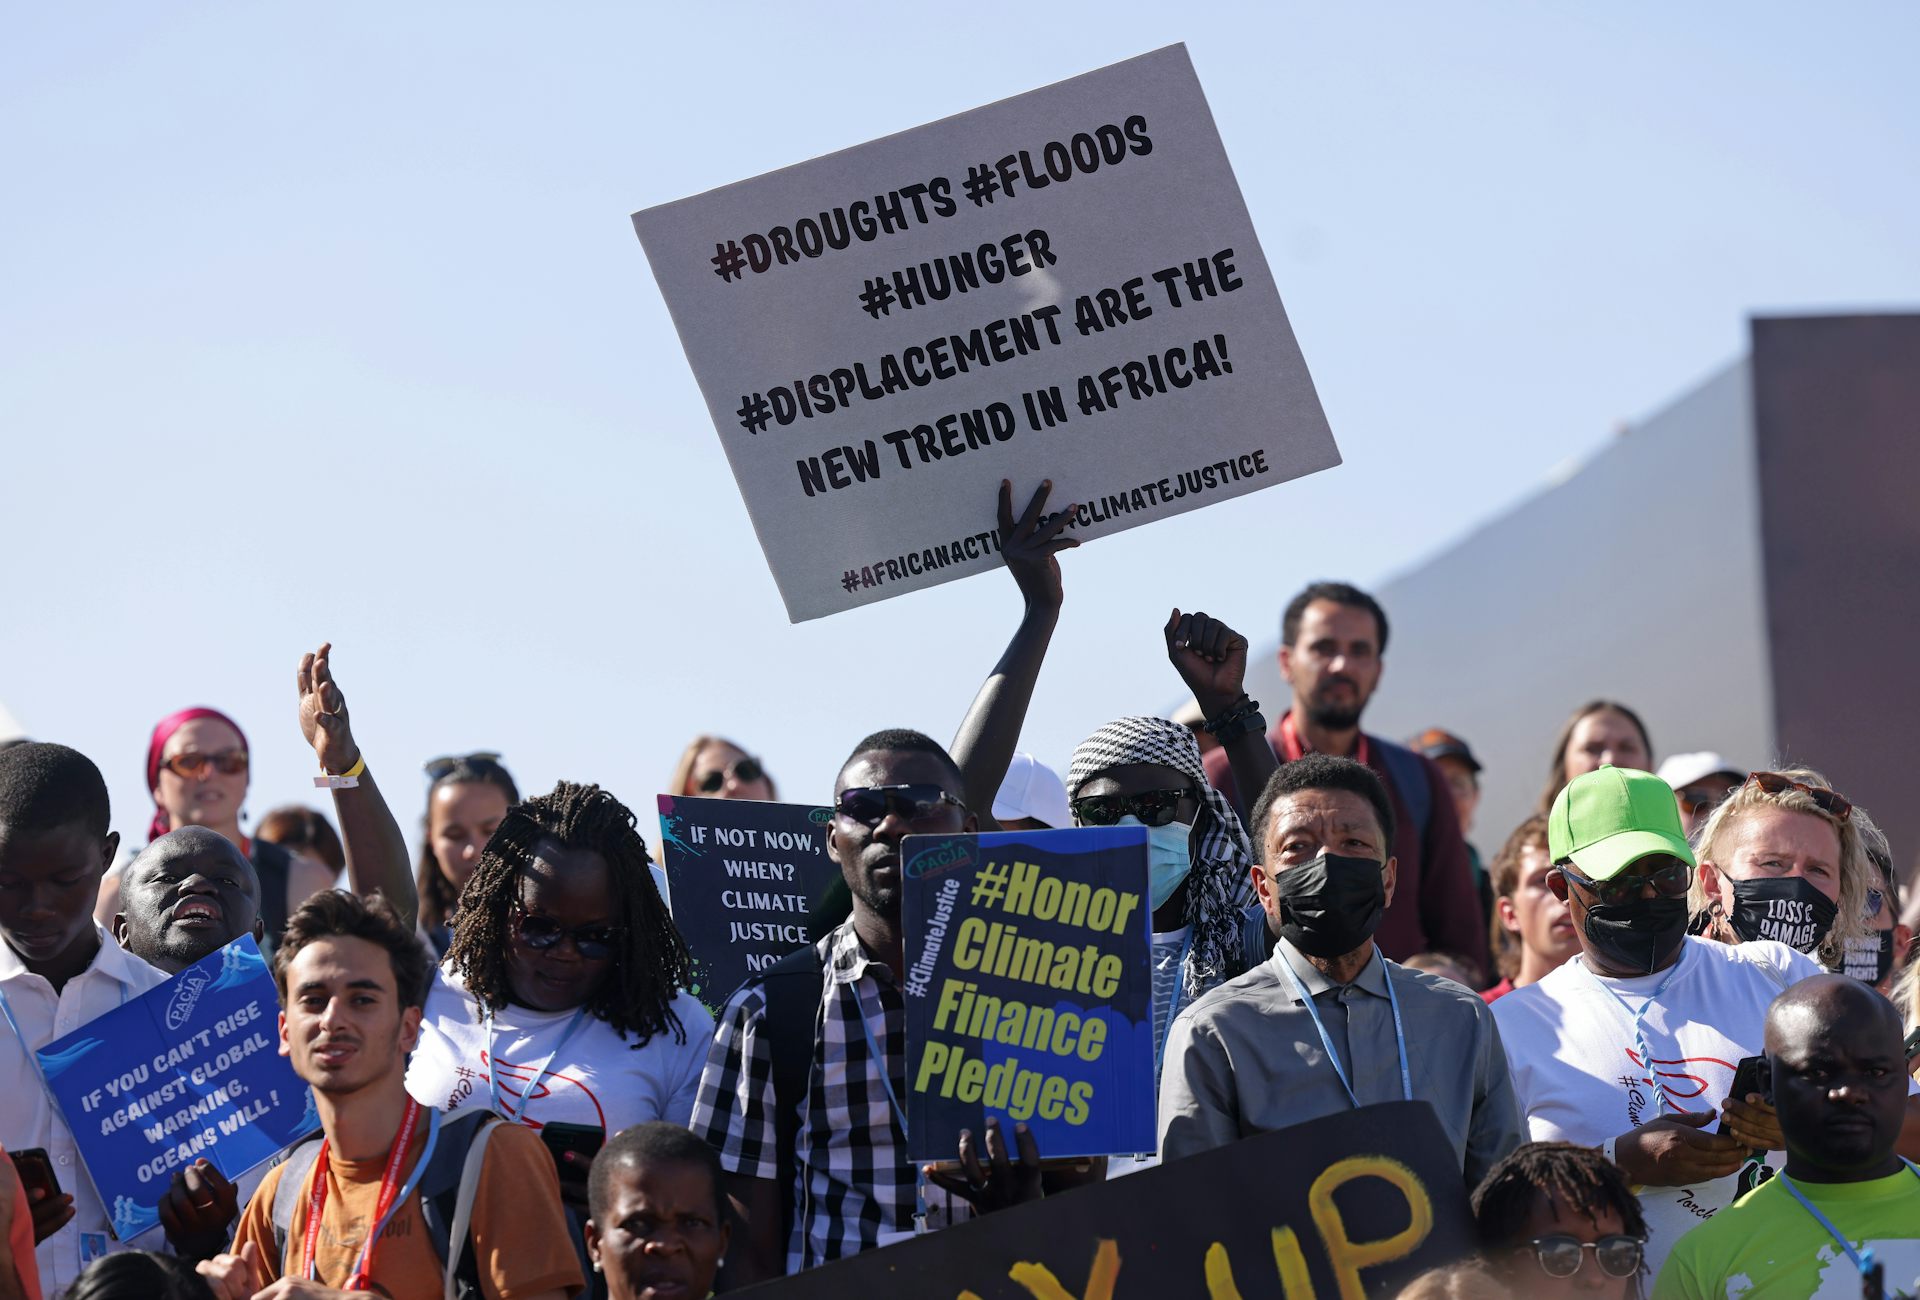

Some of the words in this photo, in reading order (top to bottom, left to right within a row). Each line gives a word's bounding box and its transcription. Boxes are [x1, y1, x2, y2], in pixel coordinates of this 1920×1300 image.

[711, 176, 957, 283] #DROUGHTS
[962, 115, 1153, 207] #FLOODS
[859, 229, 1058, 319] #HUNGER
[736, 305, 1062, 435] #DISPLACEMENT
[1074, 280, 1152, 336] ARE
[1153, 248, 1243, 309] THE
[796, 439, 879, 497] NEW
[884, 402, 1015, 471] TREND
[1023, 386, 1068, 431] IN
[1077, 334, 1232, 416] AFRICA!
[1068, 449, 1269, 530] CLIMATEJUSTICE
[690, 825, 707, 844] IF
[715, 828, 757, 847] NOT
[764, 831, 820, 855] NOW,
[723, 860, 795, 881] WHEN?
[916, 847, 968, 873] PACJA
[721, 890, 809, 913] CLIMATE
[730, 922, 810, 944] JUSTICE
[971, 861, 1139, 935] #Honor
[1760, 919, 1817, 946] DAMAGE
[1768, 899, 1803, 923] LOSS
[1805, 904, 1812, 922] &
[747, 954, 783, 972] NO
[905, 878, 960, 997] #ClimateJustice
[952, 917, 1122, 998] Climate
[1844, 967, 1878, 980] RIGHTS
[170, 978, 202, 1021] PACJA
[933, 979, 1107, 1062] Finance
[81, 1089, 102, 1113] IF
[105, 1064, 149, 1097] YOU
[152, 1029, 211, 1073] CAN'T
[214, 1000, 262, 1038] RISE
[100, 1076, 187, 1136] AGAINST
[191, 1032, 270, 1086] GLOBAL
[914, 1040, 1093, 1125] Pledges
[137, 1127, 217, 1183] OCEANS
[218, 1099, 270, 1136] WILL
[144, 1079, 249, 1144] WARMING,
[1677, 1189, 1717, 1220] Torch
